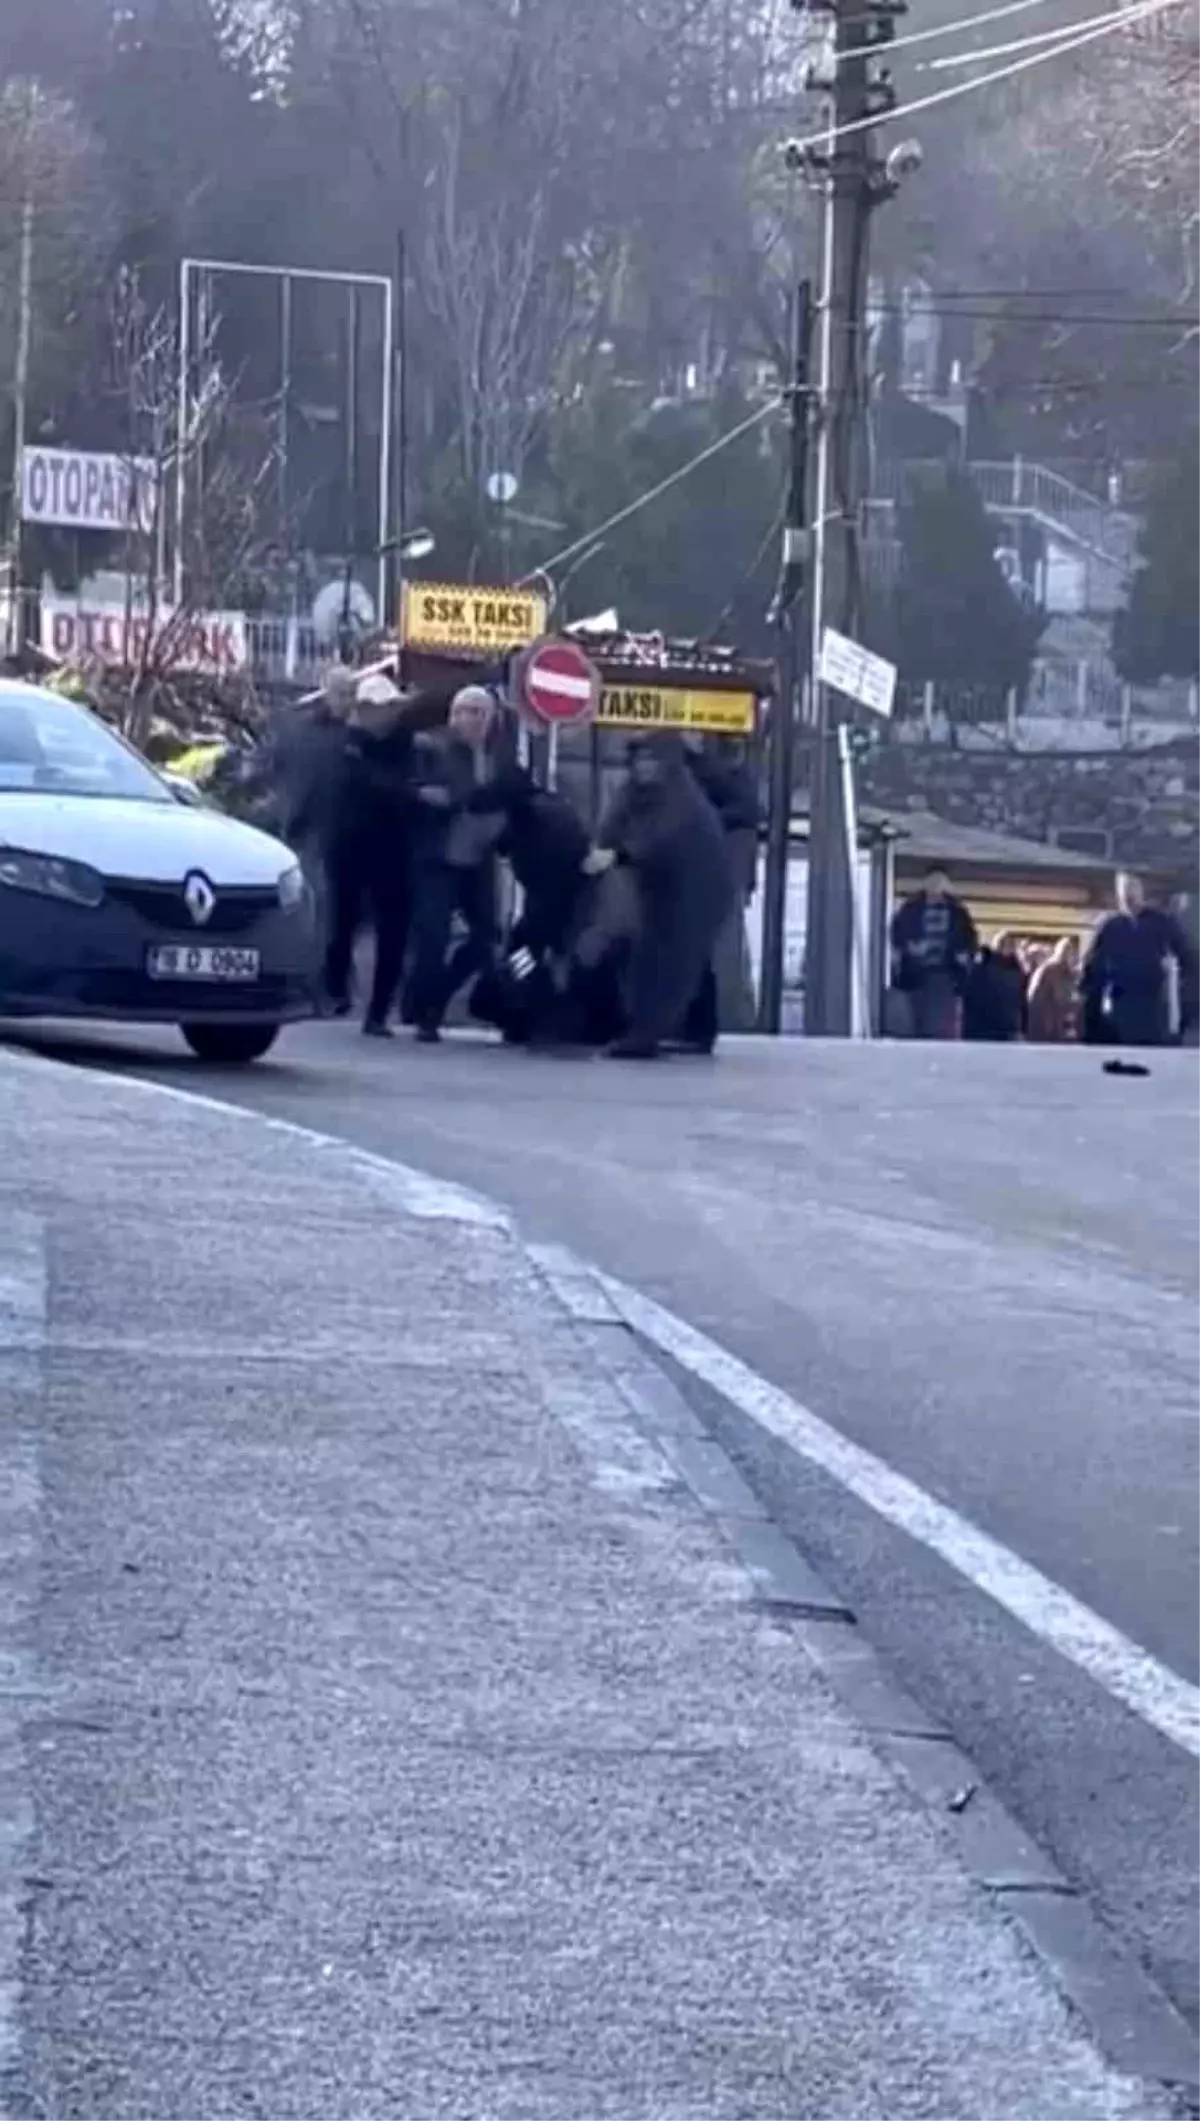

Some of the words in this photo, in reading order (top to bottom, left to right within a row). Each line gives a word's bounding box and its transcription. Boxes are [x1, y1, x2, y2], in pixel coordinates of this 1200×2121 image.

[29, 455, 153, 519] OTOPAR
[422, 596, 465, 624] SSK
[473, 600, 532, 627] TAKSI
[598, 690, 661, 720] TAKSI
